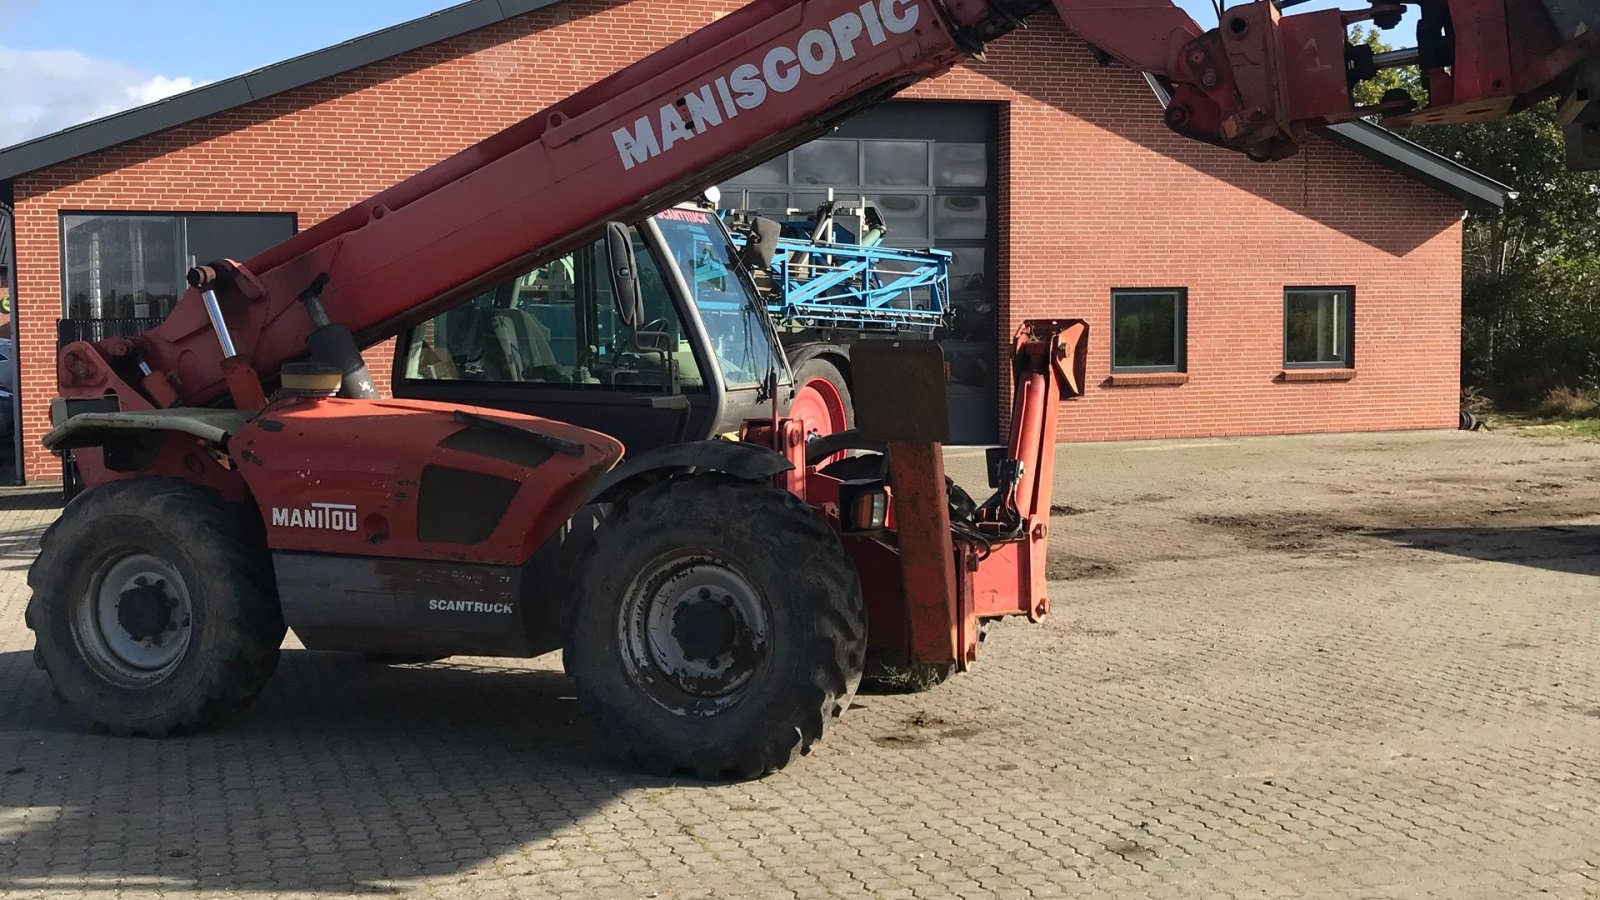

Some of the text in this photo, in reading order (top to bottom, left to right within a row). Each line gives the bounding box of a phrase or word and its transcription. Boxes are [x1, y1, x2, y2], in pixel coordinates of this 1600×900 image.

[612, 0, 919, 171] MANISCOPIC
[272, 502, 357, 531] MANITOU
[429, 599, 513, 614] SCANTRUCK
